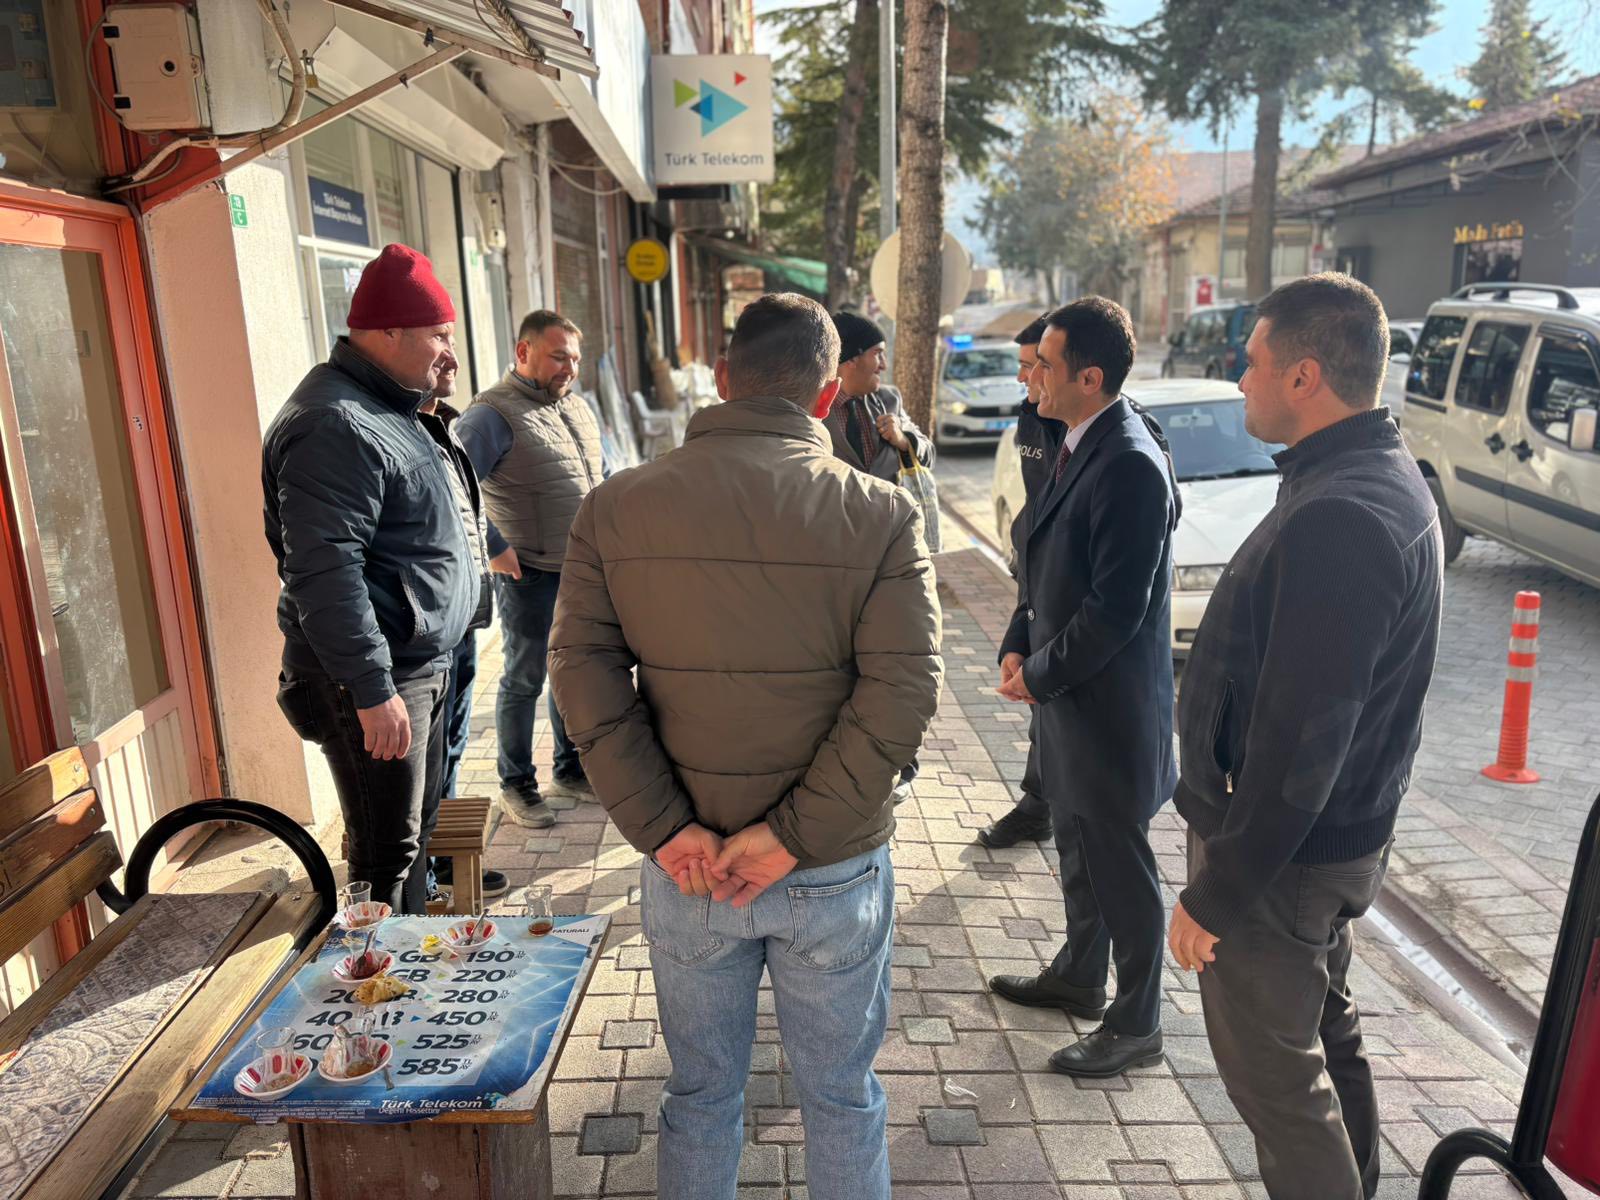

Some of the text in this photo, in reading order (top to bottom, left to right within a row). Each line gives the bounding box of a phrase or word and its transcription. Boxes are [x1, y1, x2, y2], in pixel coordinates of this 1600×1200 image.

[664, 152, 764, 166] Türk Telekom
[466, 950, 515, 963] 190
[451, 969, 506, 983] 220
[439, 989, 498, 1003] 280
[306, 1010, 353, 1026] 40
[426, 1010, 487, 1026] 450
[293, 1034, 335, 1051] 60
[412, 1034, 471, 1050] 525
[397, 1058, 461, 1075] 585
[381, 1096, 414, 1109] Türk
[419, 1099, 482, 1108] Telekom
